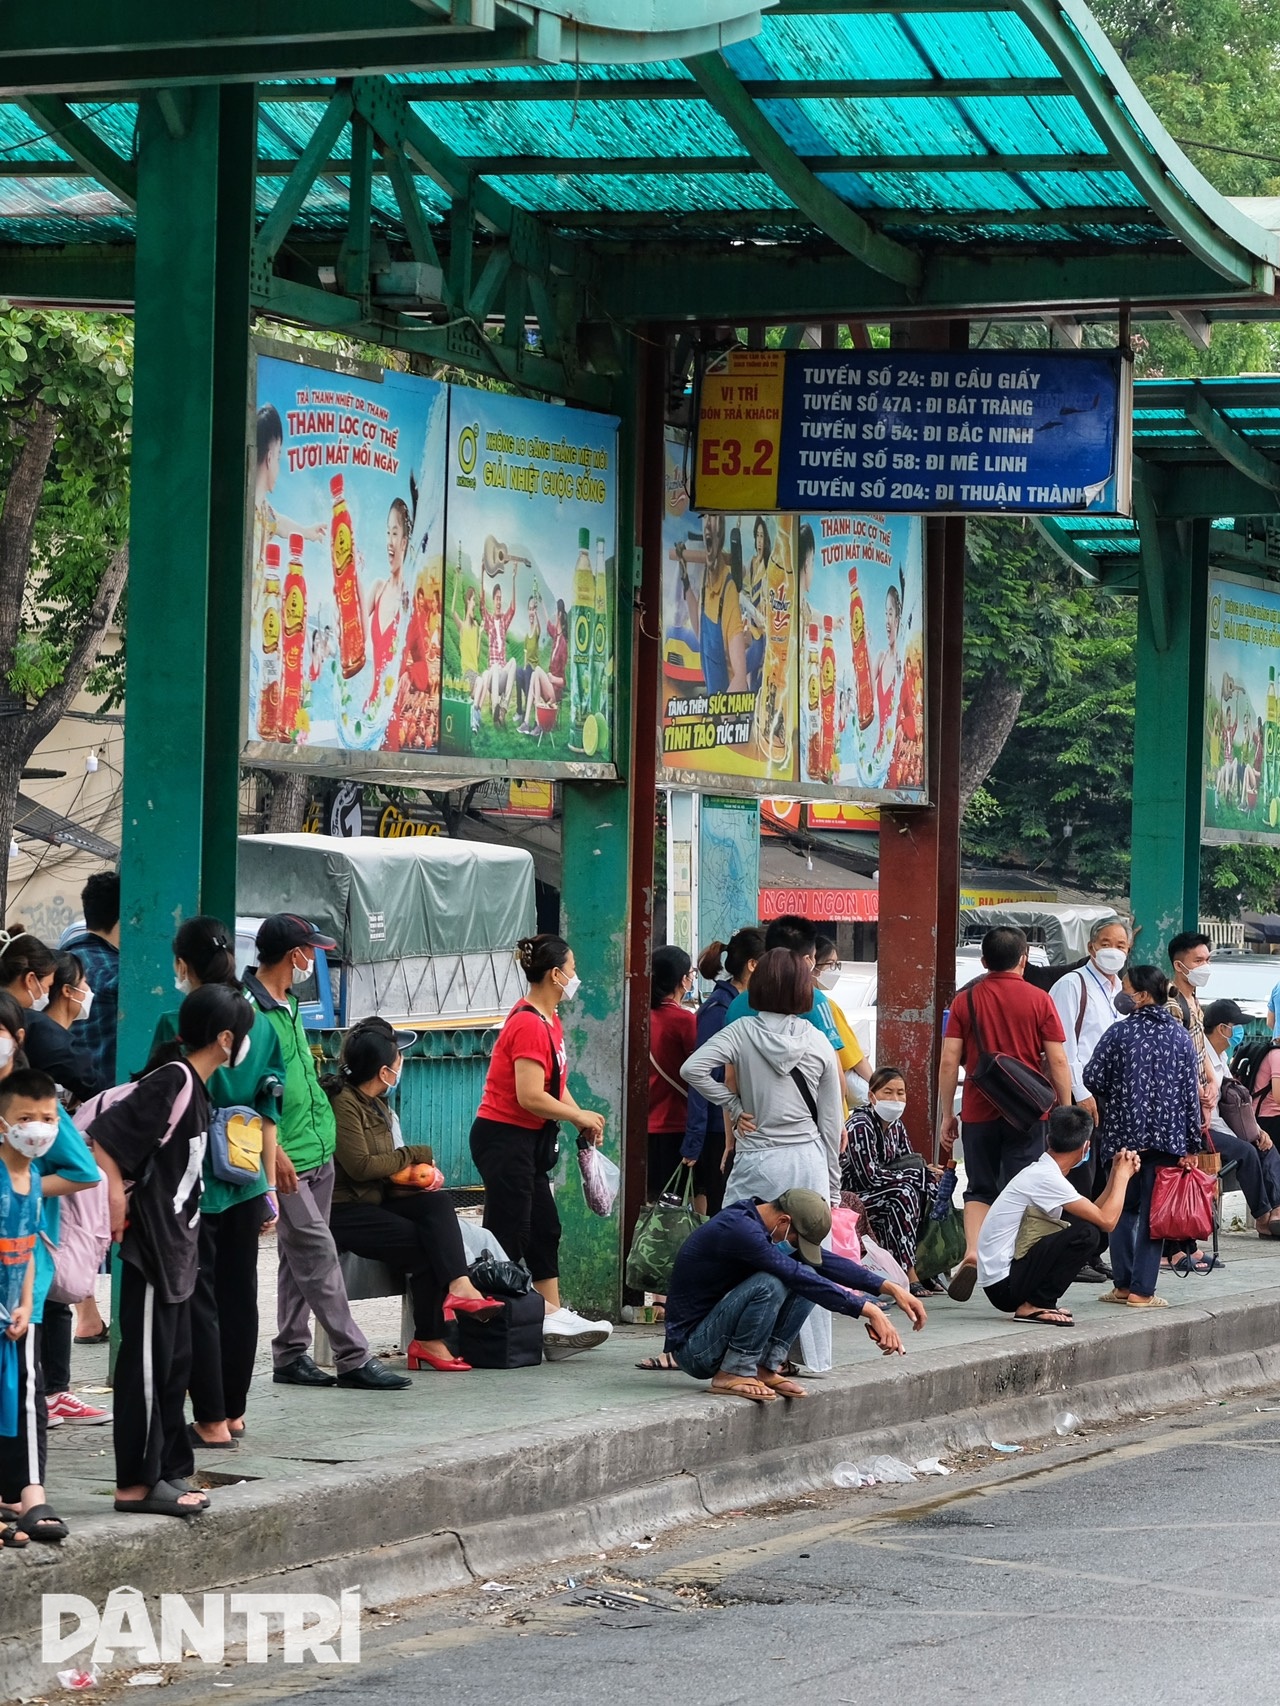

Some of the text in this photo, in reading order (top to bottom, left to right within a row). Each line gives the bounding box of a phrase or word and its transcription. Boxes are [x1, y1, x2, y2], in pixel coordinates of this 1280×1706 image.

[804, 364, 1041, 390] TUYẾN SỐ 24: ĐI CẦU GIẤY
[312, 390, 334, 404] THANH
[722, 384, 759, 404] VỊ TRÍ
[803, 390, 852, 410] TUYẾN
[856, 390, 879, 412] SỐ
[882, 397, 912, 413] 47A
[926, 398, 942, 413] ĐI
[947, 395, 975, 414] BÁT
[980, 396, 1034, 416] TRÀNG
[724, 405, 742, 420] TRẢ
[746, 406, 780, 420] KHÁCH
[288, 412, 335, 436] THANH
[339, 414, 360, 439] LỌC
[362, 420, 378, 440] CƠ
[800, 417, 1034, 444] TUYẾN SỐ 54: ĐI BẮC NINH
[288, 444, 322, 472] TƯƠI
[326, 438, 350, 464] MÁT
[374, 452, 399, 474] NGÀY
[486, 430, 515, 455] KHÔNG
[528, 436, 550, 460] CĂNG
[702, 439, 774, 476] E3.2
[799, 446, 1028, 472] TUYẾN SỐ 58: ĐI MÊ LINH
[483, 455, 606, 504] GIẢI NHIỆT CUỘC SỐNG
[797, 476, 855, 498] TUYẾN
[860, 477, 886, 498] SỐ
[891, 483, 930, 500] 204:
[936, 484, 954, 500] ĐI
[960, 482, 1021, 505] THUẬN
[821, 518, 850, 538] THANH
[821, 544, 844, 566] TƯƠI
[846, 538, 860, 560] MÁT
[708, 691, 727, 714] SỨC
[728, 693, 755, 716] MẠNH
[694, 717, 715, 748] TÁO
[764, 891, 808, 914] NGAN
[812, 892, 857, 915] NGON
